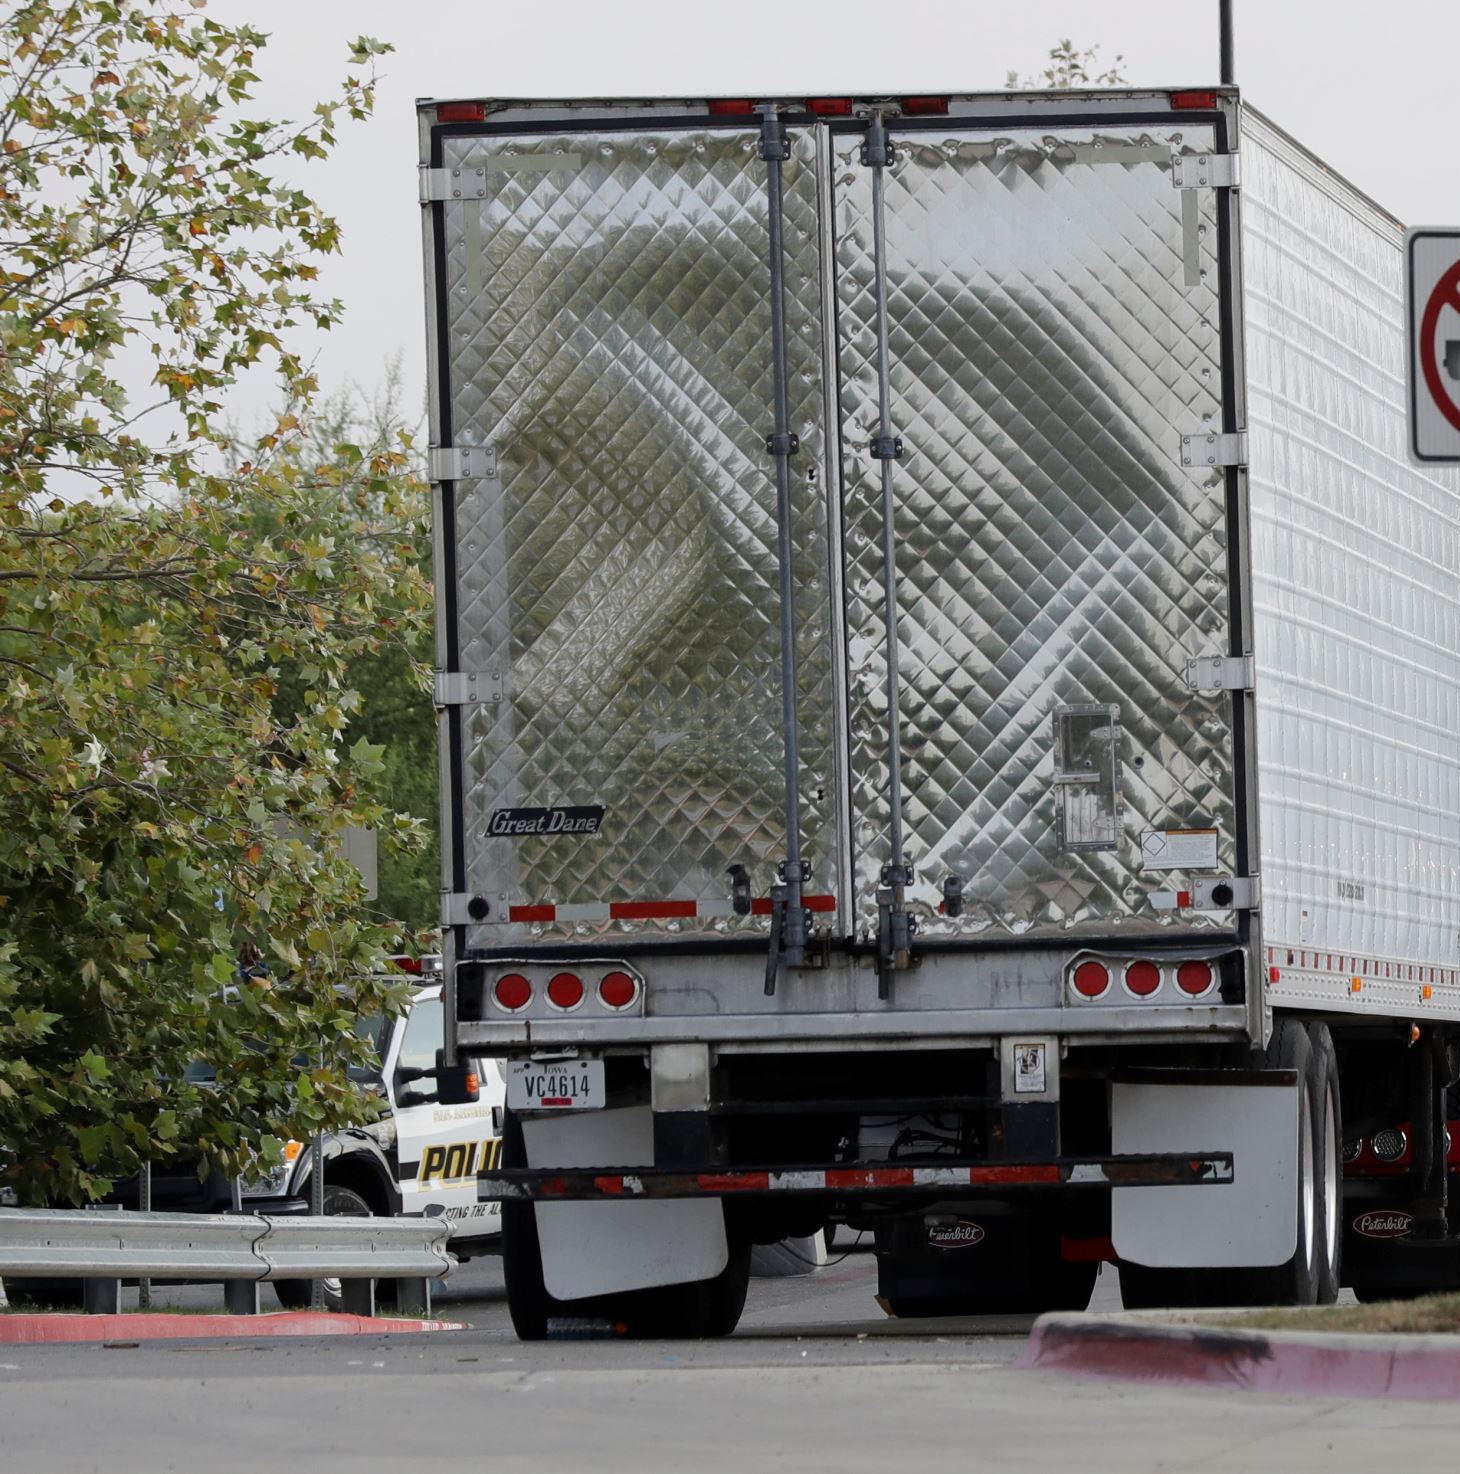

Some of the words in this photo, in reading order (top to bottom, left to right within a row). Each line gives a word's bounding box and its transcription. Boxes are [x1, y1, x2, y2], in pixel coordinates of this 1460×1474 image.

[492, 811, 546, 834] Great
[546, 810, 598, 832] Dane
[525, 1075, 590, 1098] VC4614
[470, 1203, 488, 1217] THE
[488, 1203, 503, 1216] AL
[1361, 1215, 1412, 1232] Peterbilt
